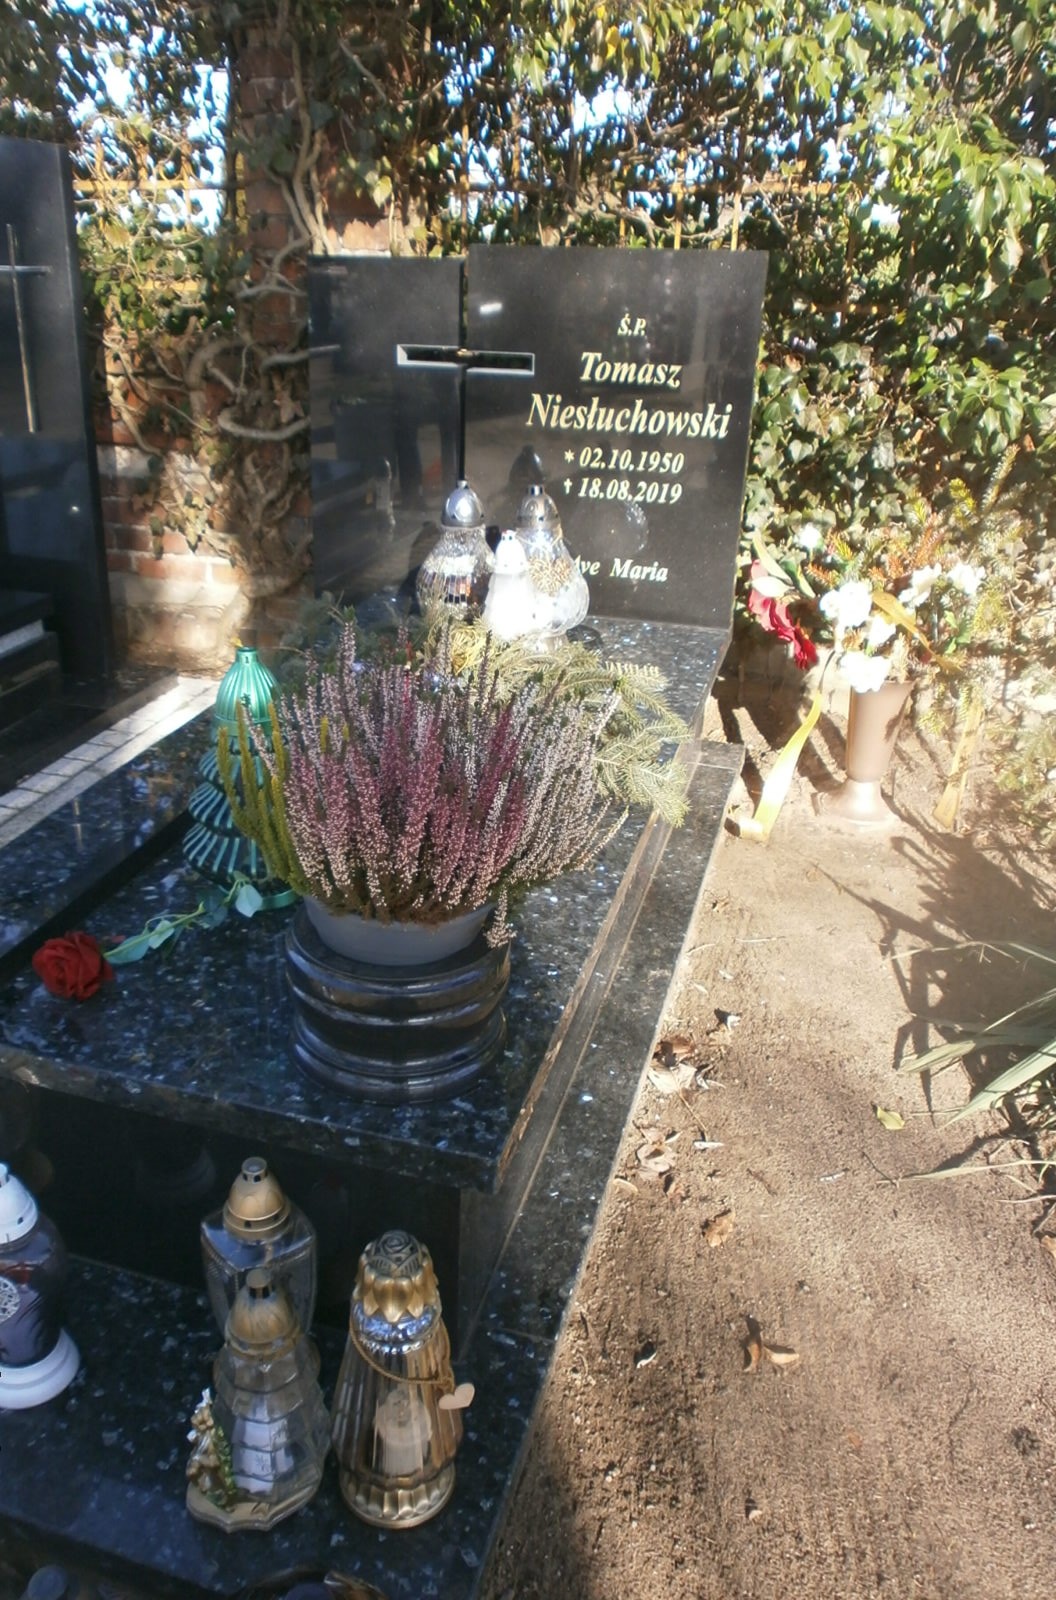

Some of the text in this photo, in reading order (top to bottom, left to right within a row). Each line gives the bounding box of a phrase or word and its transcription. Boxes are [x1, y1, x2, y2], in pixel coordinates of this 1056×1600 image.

[580, 352, 682, 388] Tomasz
[526, 393, 733, 438] Niesłuchowski
[579, 447, 685, 474] 02.10.1950
[578, 477, 683, 504] 18.08.2019
[610, 558, 668, 582] Maria
